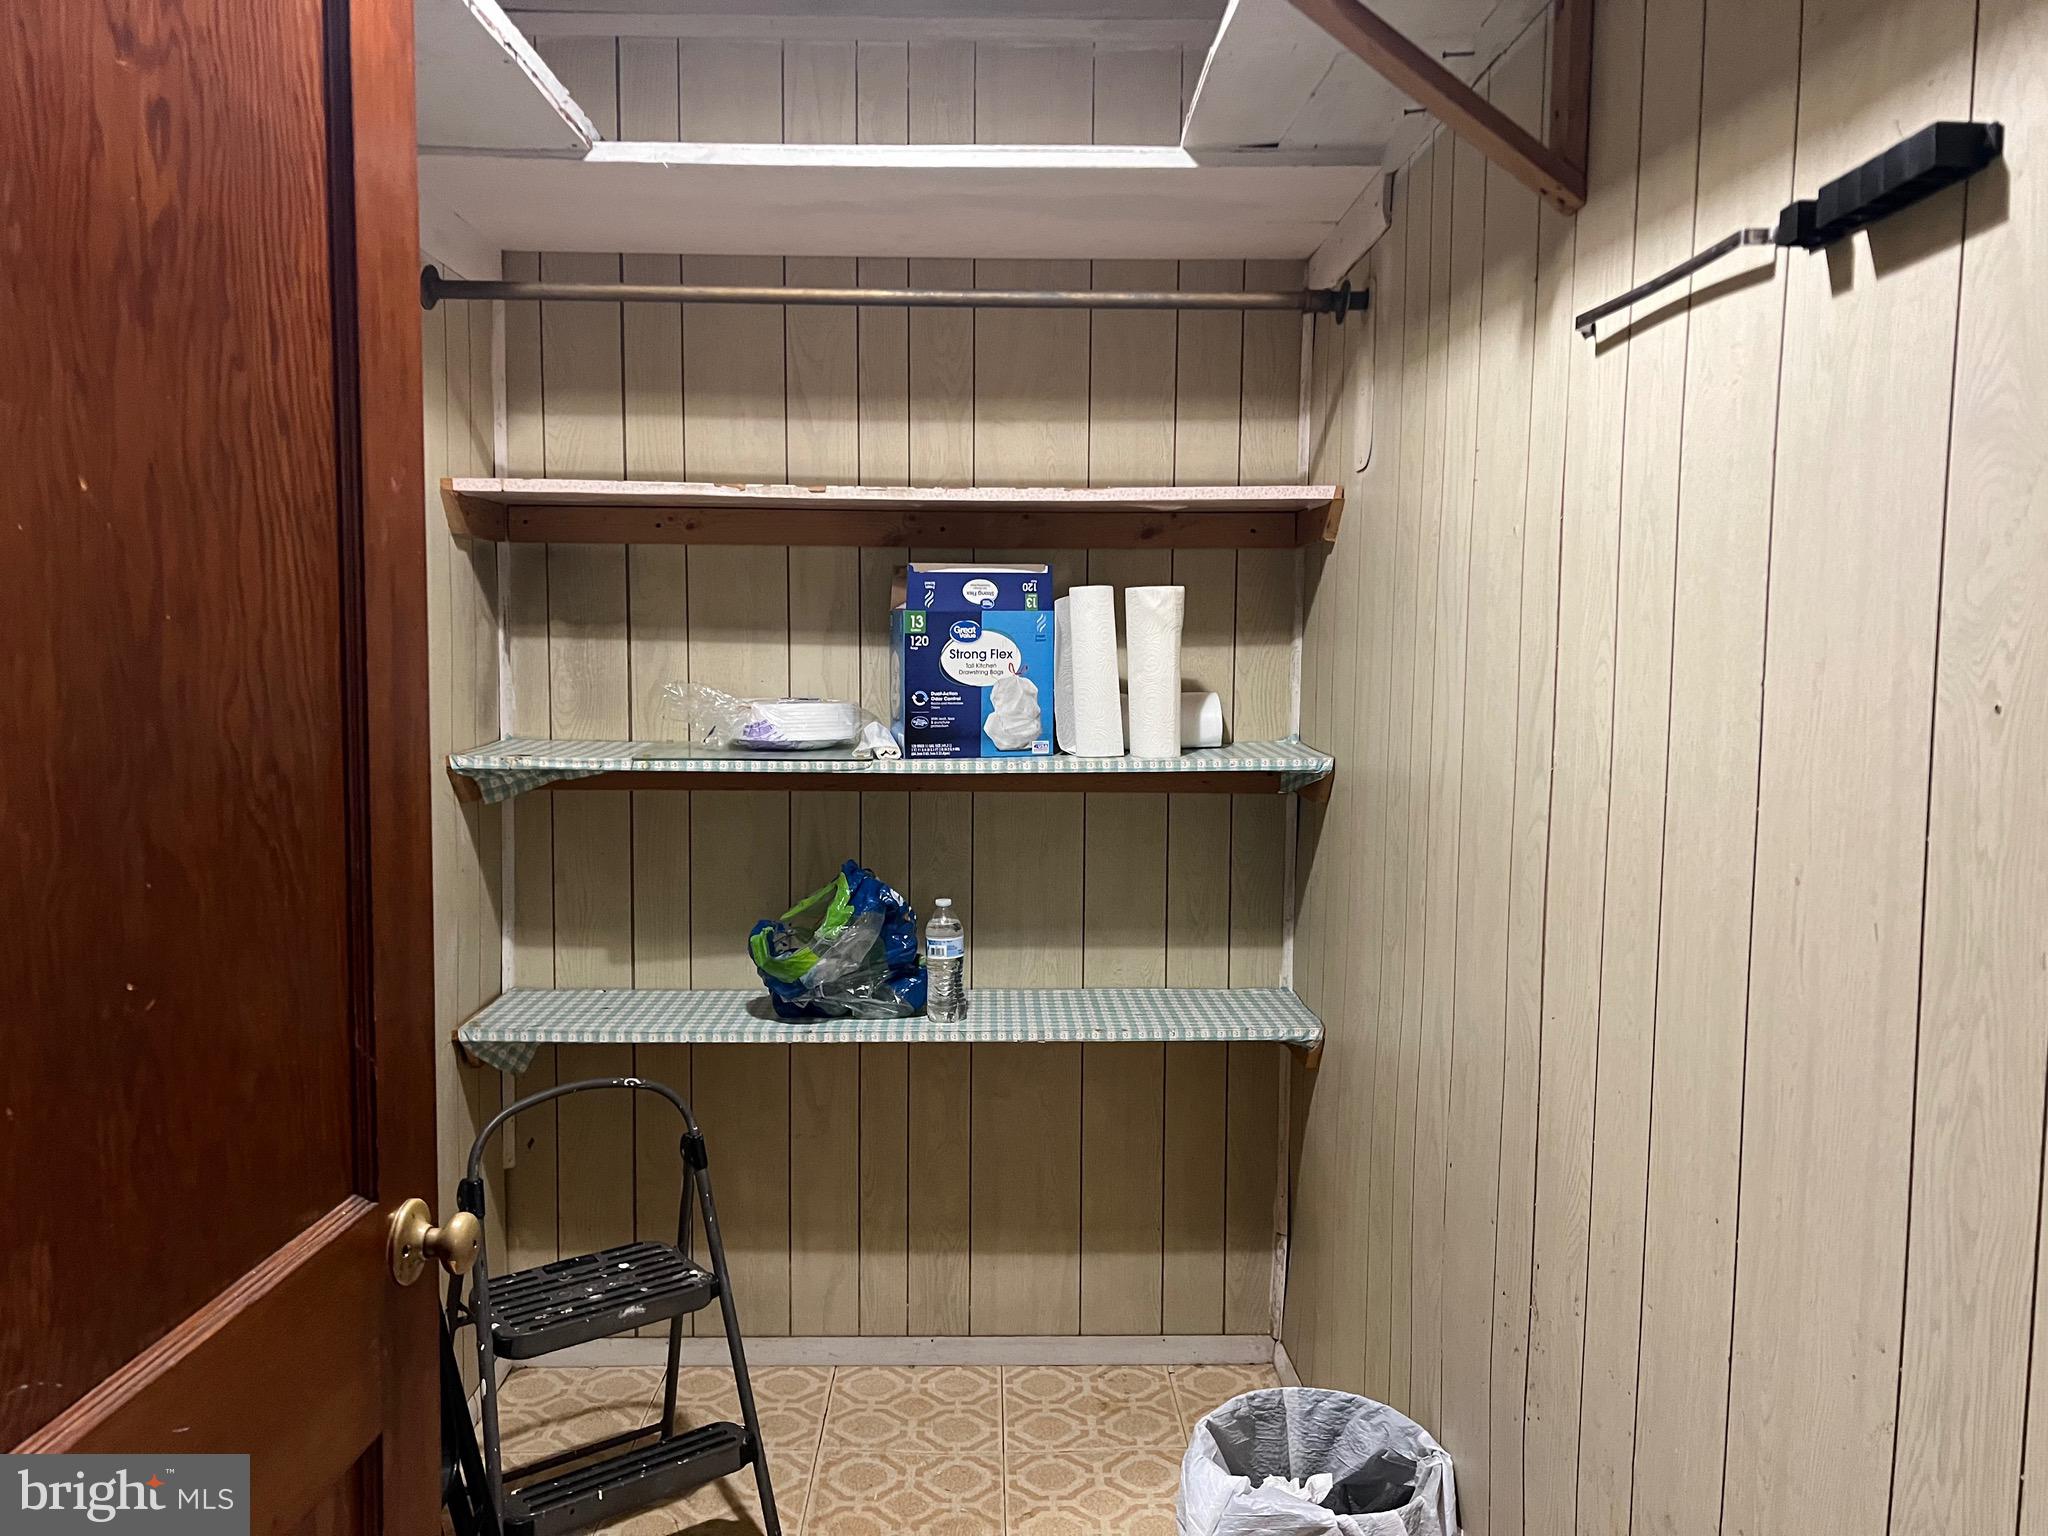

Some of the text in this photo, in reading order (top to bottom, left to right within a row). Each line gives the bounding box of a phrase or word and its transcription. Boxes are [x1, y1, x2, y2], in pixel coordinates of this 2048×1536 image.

[1022, 582, 1037, 591] 120
[1026, 598, 1037, 608] 13
[910, 615, 924, 628] 13
[953, 625, 976, 634] Great
[910, 635, 929, 646] 120
[949, 648, 1013, 662] Strong Flex
